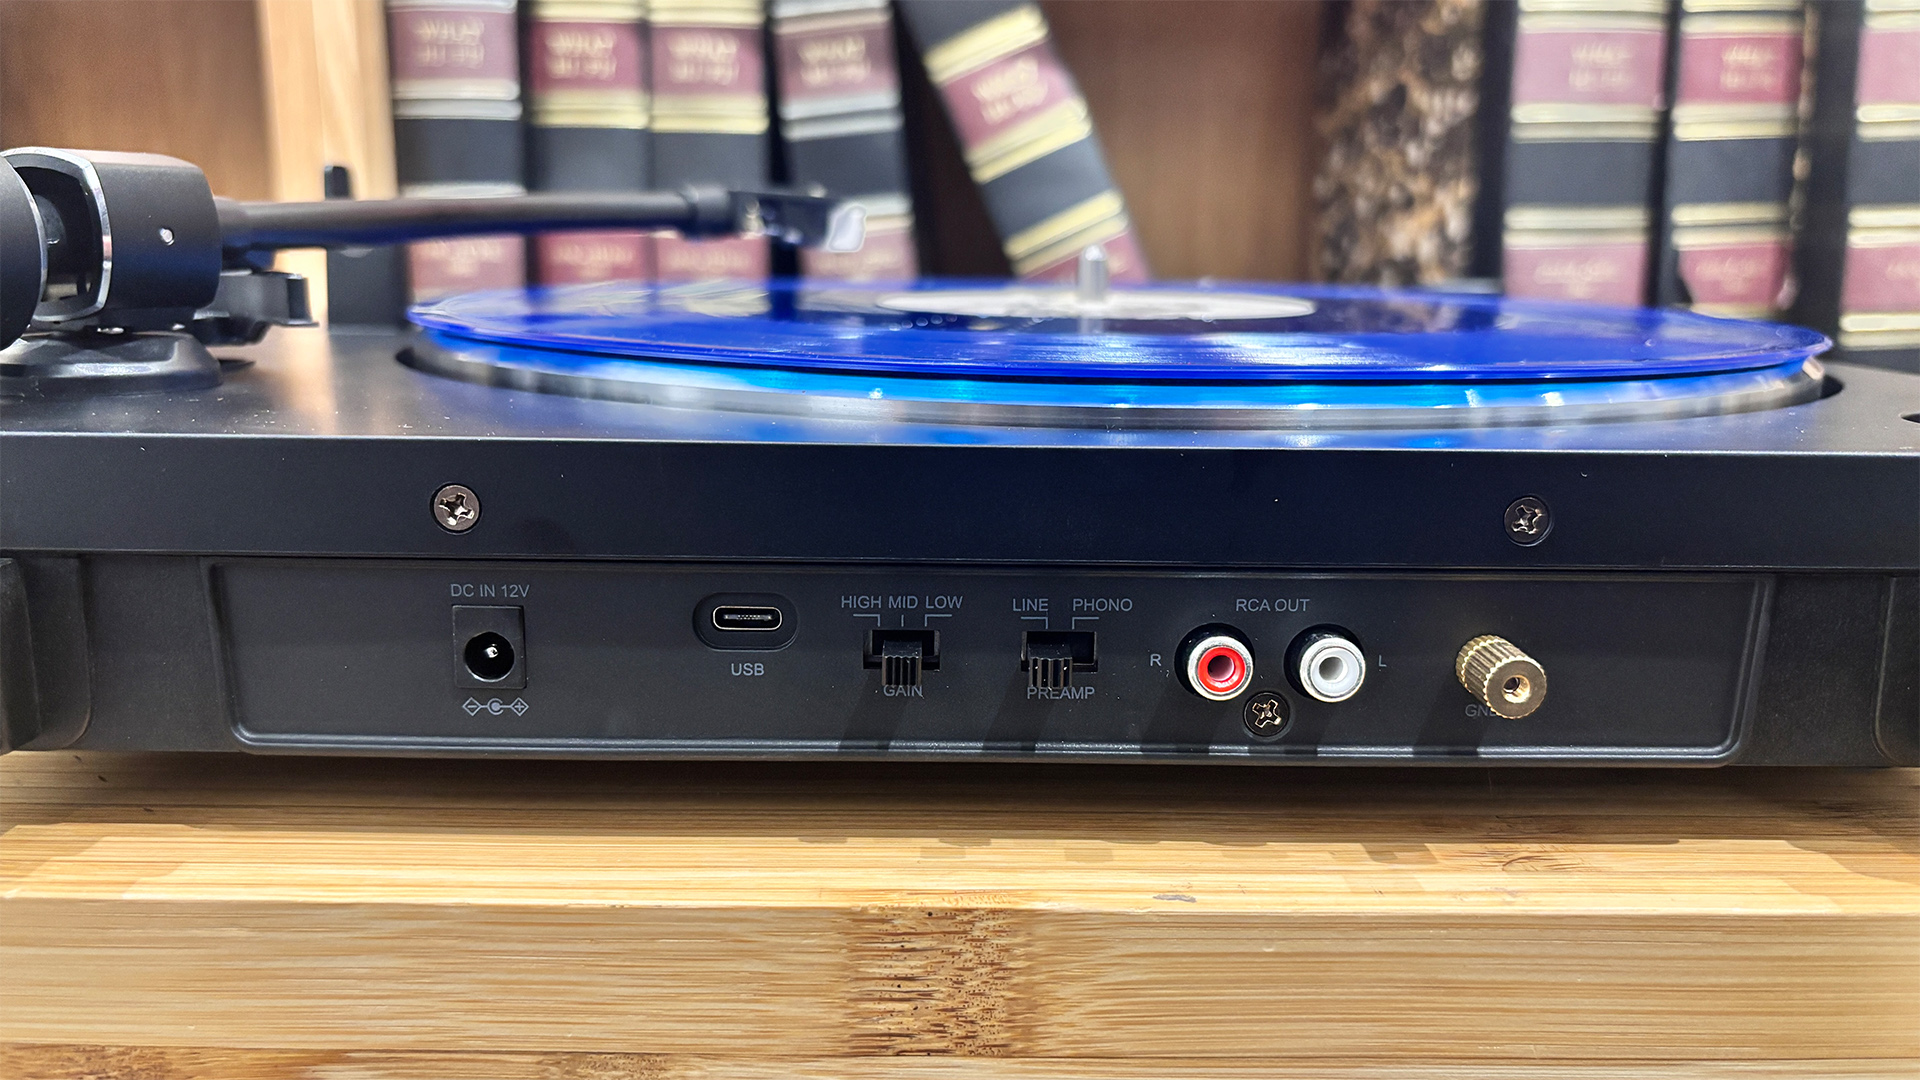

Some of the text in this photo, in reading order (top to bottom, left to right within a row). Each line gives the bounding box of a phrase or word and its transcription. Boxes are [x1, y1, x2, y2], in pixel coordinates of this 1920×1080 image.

[450, 583, 530, 598] DC IN 12V
[841, 595, 963, 609] HIGH MID LOW
[1012, 598, 1049, 612] LINE
[1072, 598, 1133, 612] PHONO
[1235, 598, 1310, 612] RCA OUT
[1149, 653, 1162, 667] R
[1378, 654, 1387, 667] L
[731, 662, 765, 677] USB
[883, 685, 923, 698] GAIN
[1026, 686, 1095, 700] PREAMP
[1465, 703, 1498, 718] GN
